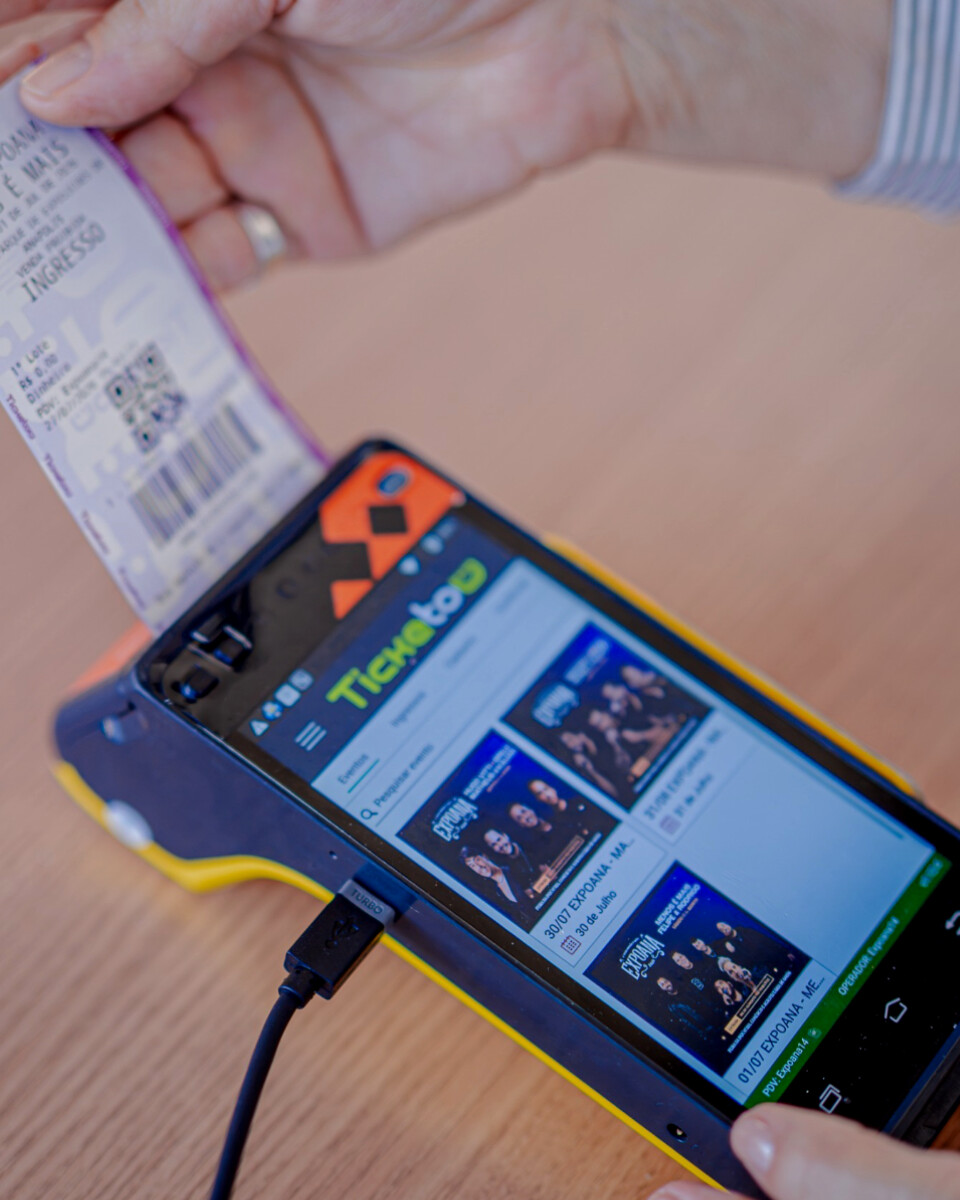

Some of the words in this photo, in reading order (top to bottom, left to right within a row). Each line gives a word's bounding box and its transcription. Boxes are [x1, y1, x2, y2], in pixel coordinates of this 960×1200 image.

[22, 135, 69, 180] MAIS
[16, 252, 43, 277] VENDA
[22, 222, 105, 302] INGRESSO
[26, 341, 47, 363] Lote
[336, 753, 369, 784] Eventos
[372, 769, 409, 807] Pesquisar
[408, 744, 433, 770] evento
[433, 798, 475, 841] EXPOANA
[350, 887, 383, 917] TURBO
[543, 907, 571, 939] 30/07
[567, 863, 610, 911] EXPOANA
[574, 922, 589, 936] 30
[586, 912, 598, 925] de
[595, 890, 617, 914] Julho
[621, 934, 664, 979] EXPOANA
[737, 1050, 764, 1083] 01/07
[760, 1003, 803, 1053] EXPOANA
[762, 1077, 778, 1096] PDV:
[775, 1037, 809, 1079] Expoana14
